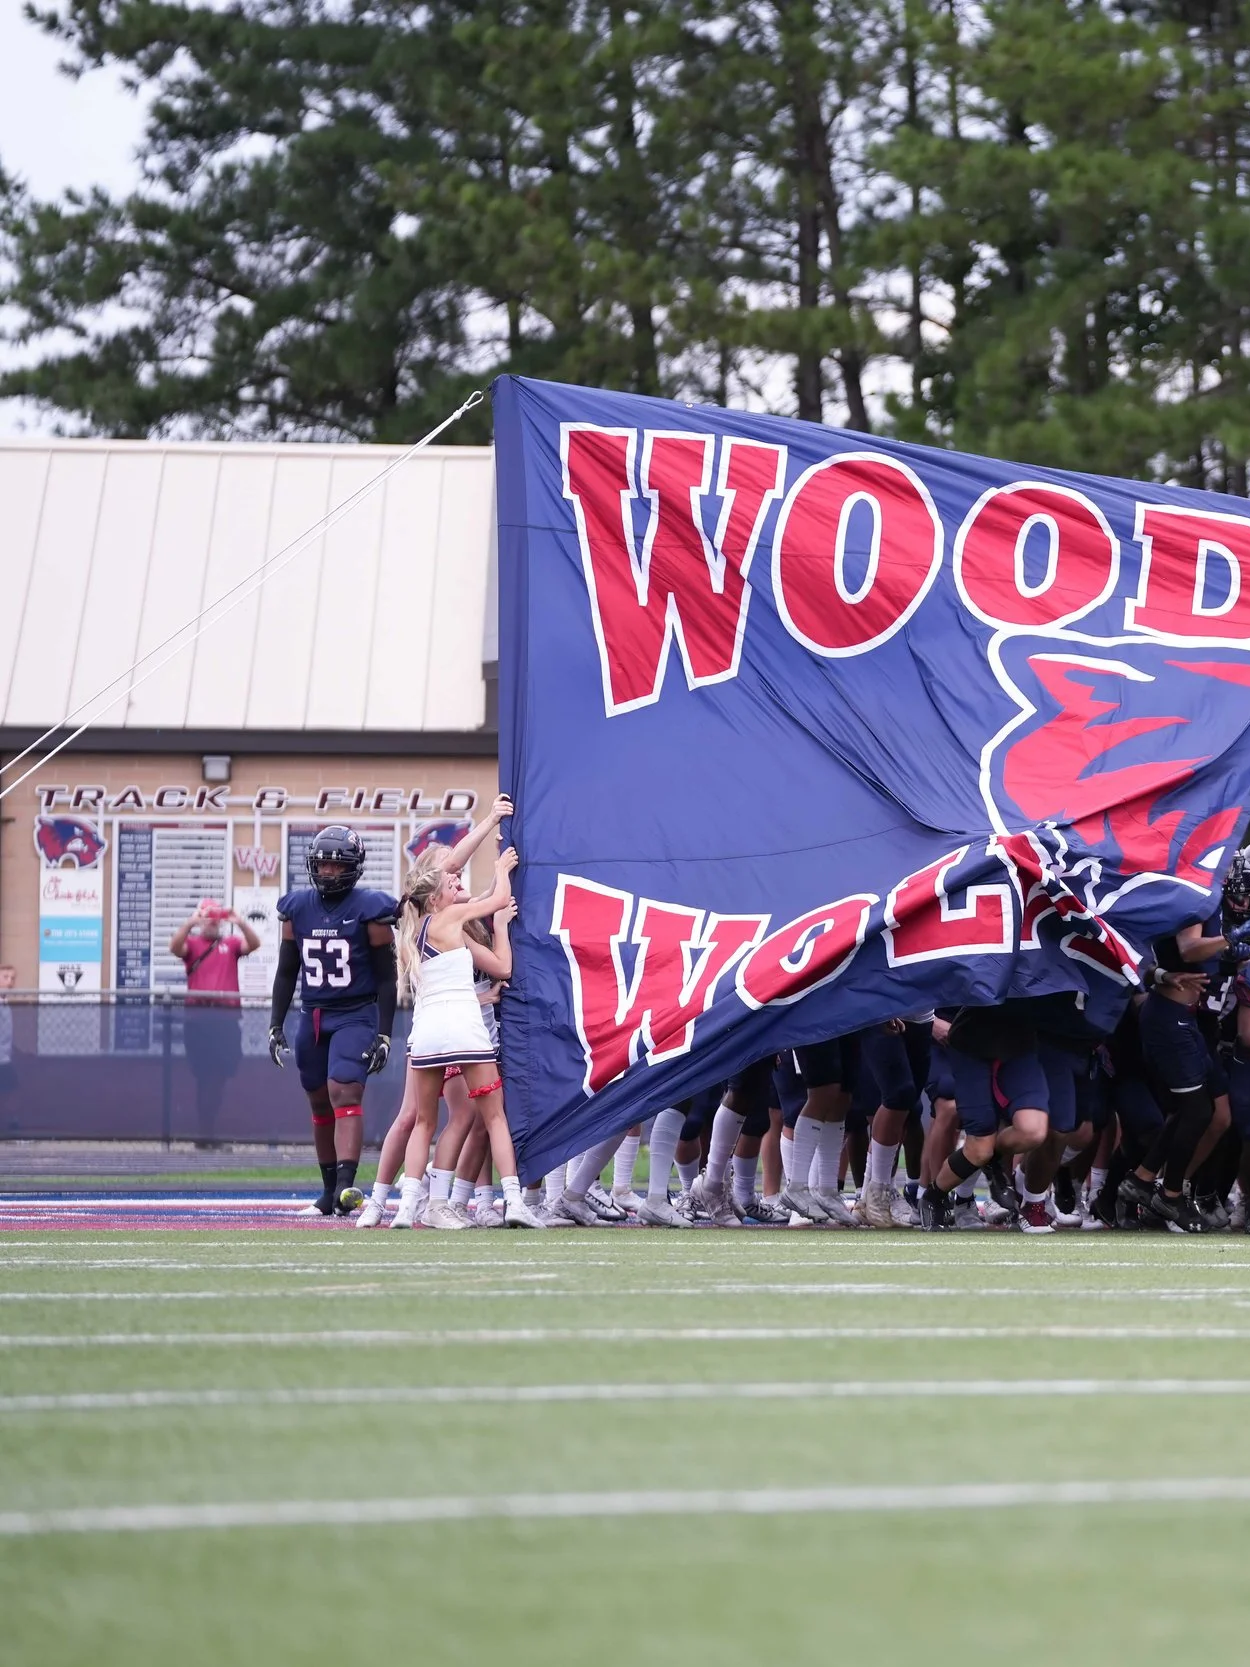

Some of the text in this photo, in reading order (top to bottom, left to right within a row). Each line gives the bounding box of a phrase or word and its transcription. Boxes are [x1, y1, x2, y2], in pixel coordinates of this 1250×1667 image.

[36, 785, 231, 812] TRACK
[315, 787, 478, 815] FIELD
[302, 938, 351, 988] 53
